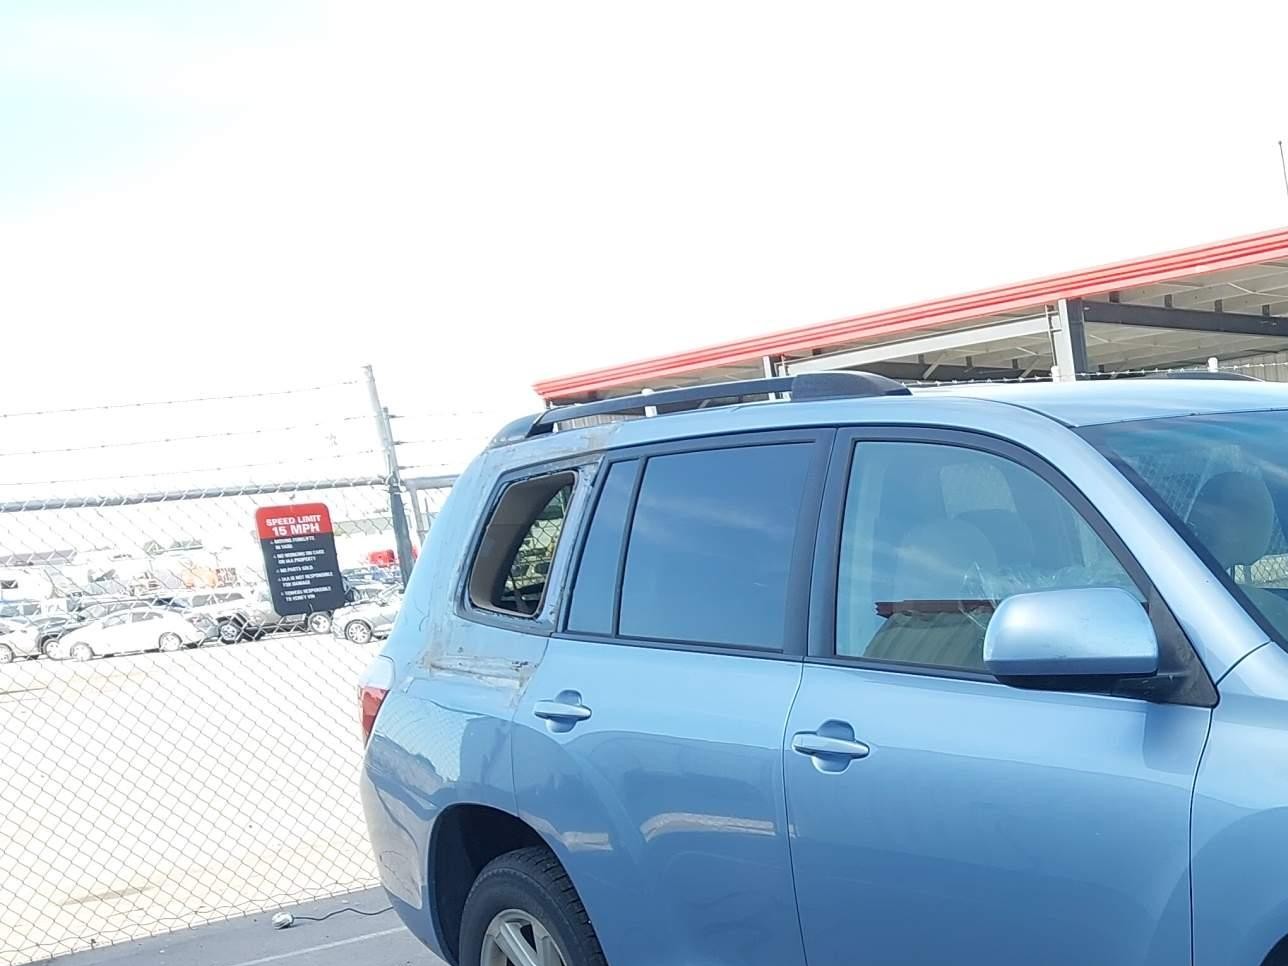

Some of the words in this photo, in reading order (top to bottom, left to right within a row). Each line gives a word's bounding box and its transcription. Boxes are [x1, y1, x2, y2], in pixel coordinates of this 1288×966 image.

[266, 517, 296, 526] SPEED
[297, 515, 321, 524] LIMIT
[272, 526, 287, 536] 15
[290, 523, 320, 535] MPH
